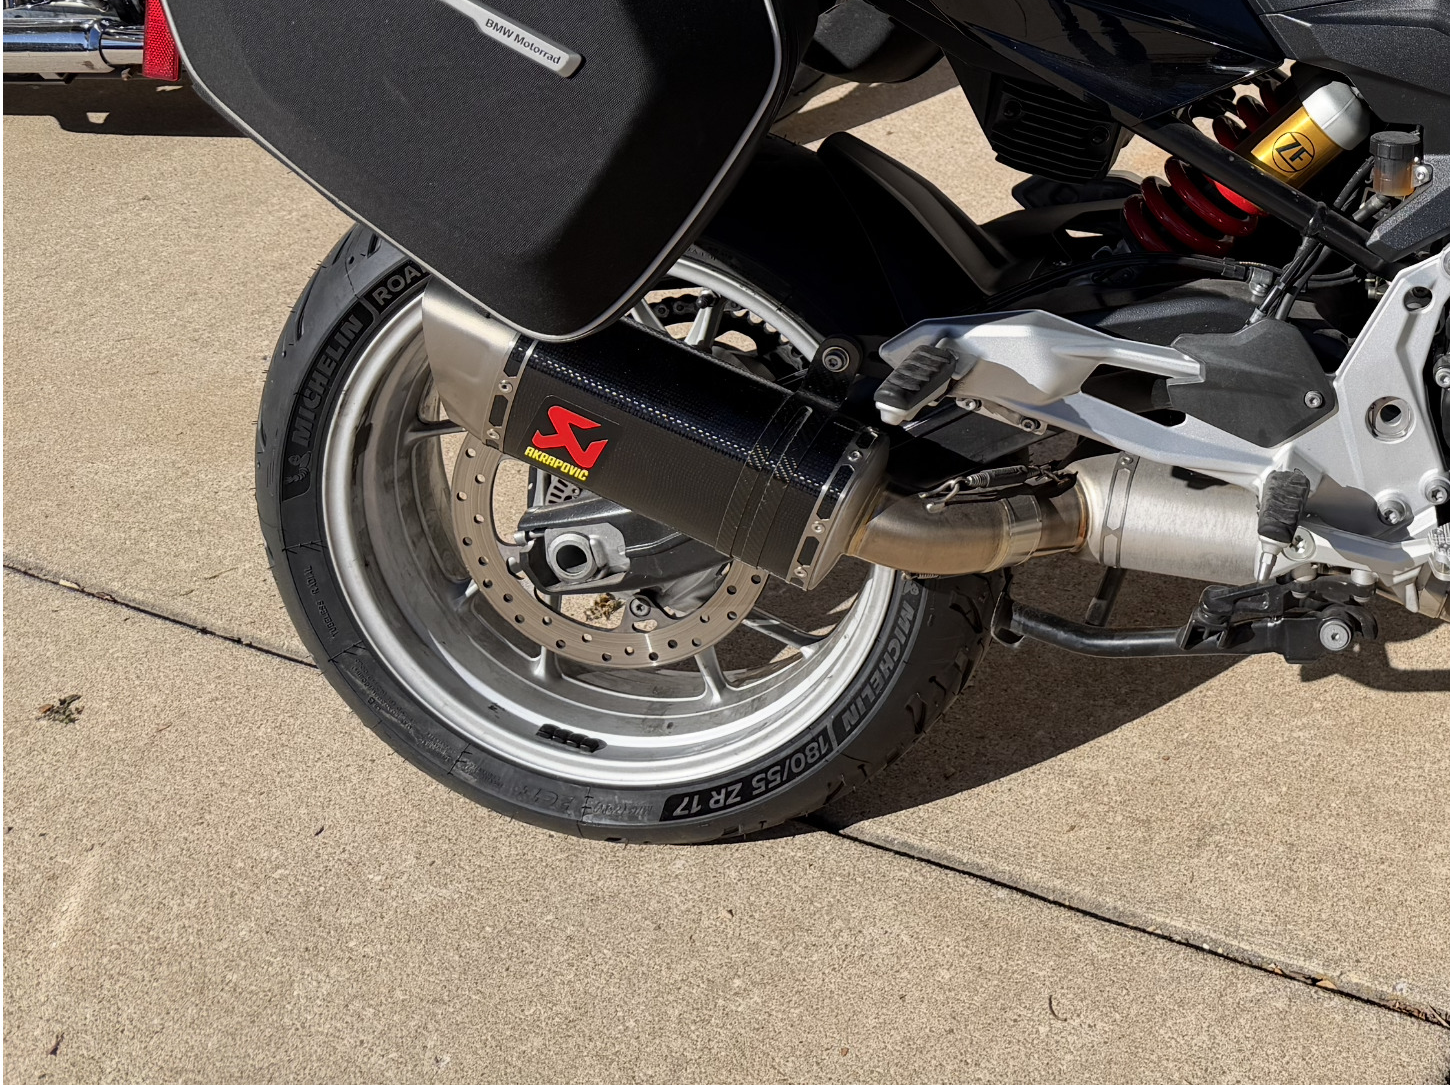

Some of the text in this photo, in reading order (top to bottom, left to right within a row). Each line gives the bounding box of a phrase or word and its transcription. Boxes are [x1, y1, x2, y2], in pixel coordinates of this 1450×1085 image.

[485, 18, 562, 65] BMW Motorrad
[291, 314, 365, 449] MICHELIN
[524, 446, 589, 482] AKRAPOVIC
[304, 564, 339, 637] TUBELESS RADIAL
[842, 601, 915, 733] MICHELIN
[672, 735, 830, 818] 180/55 ZR 17
